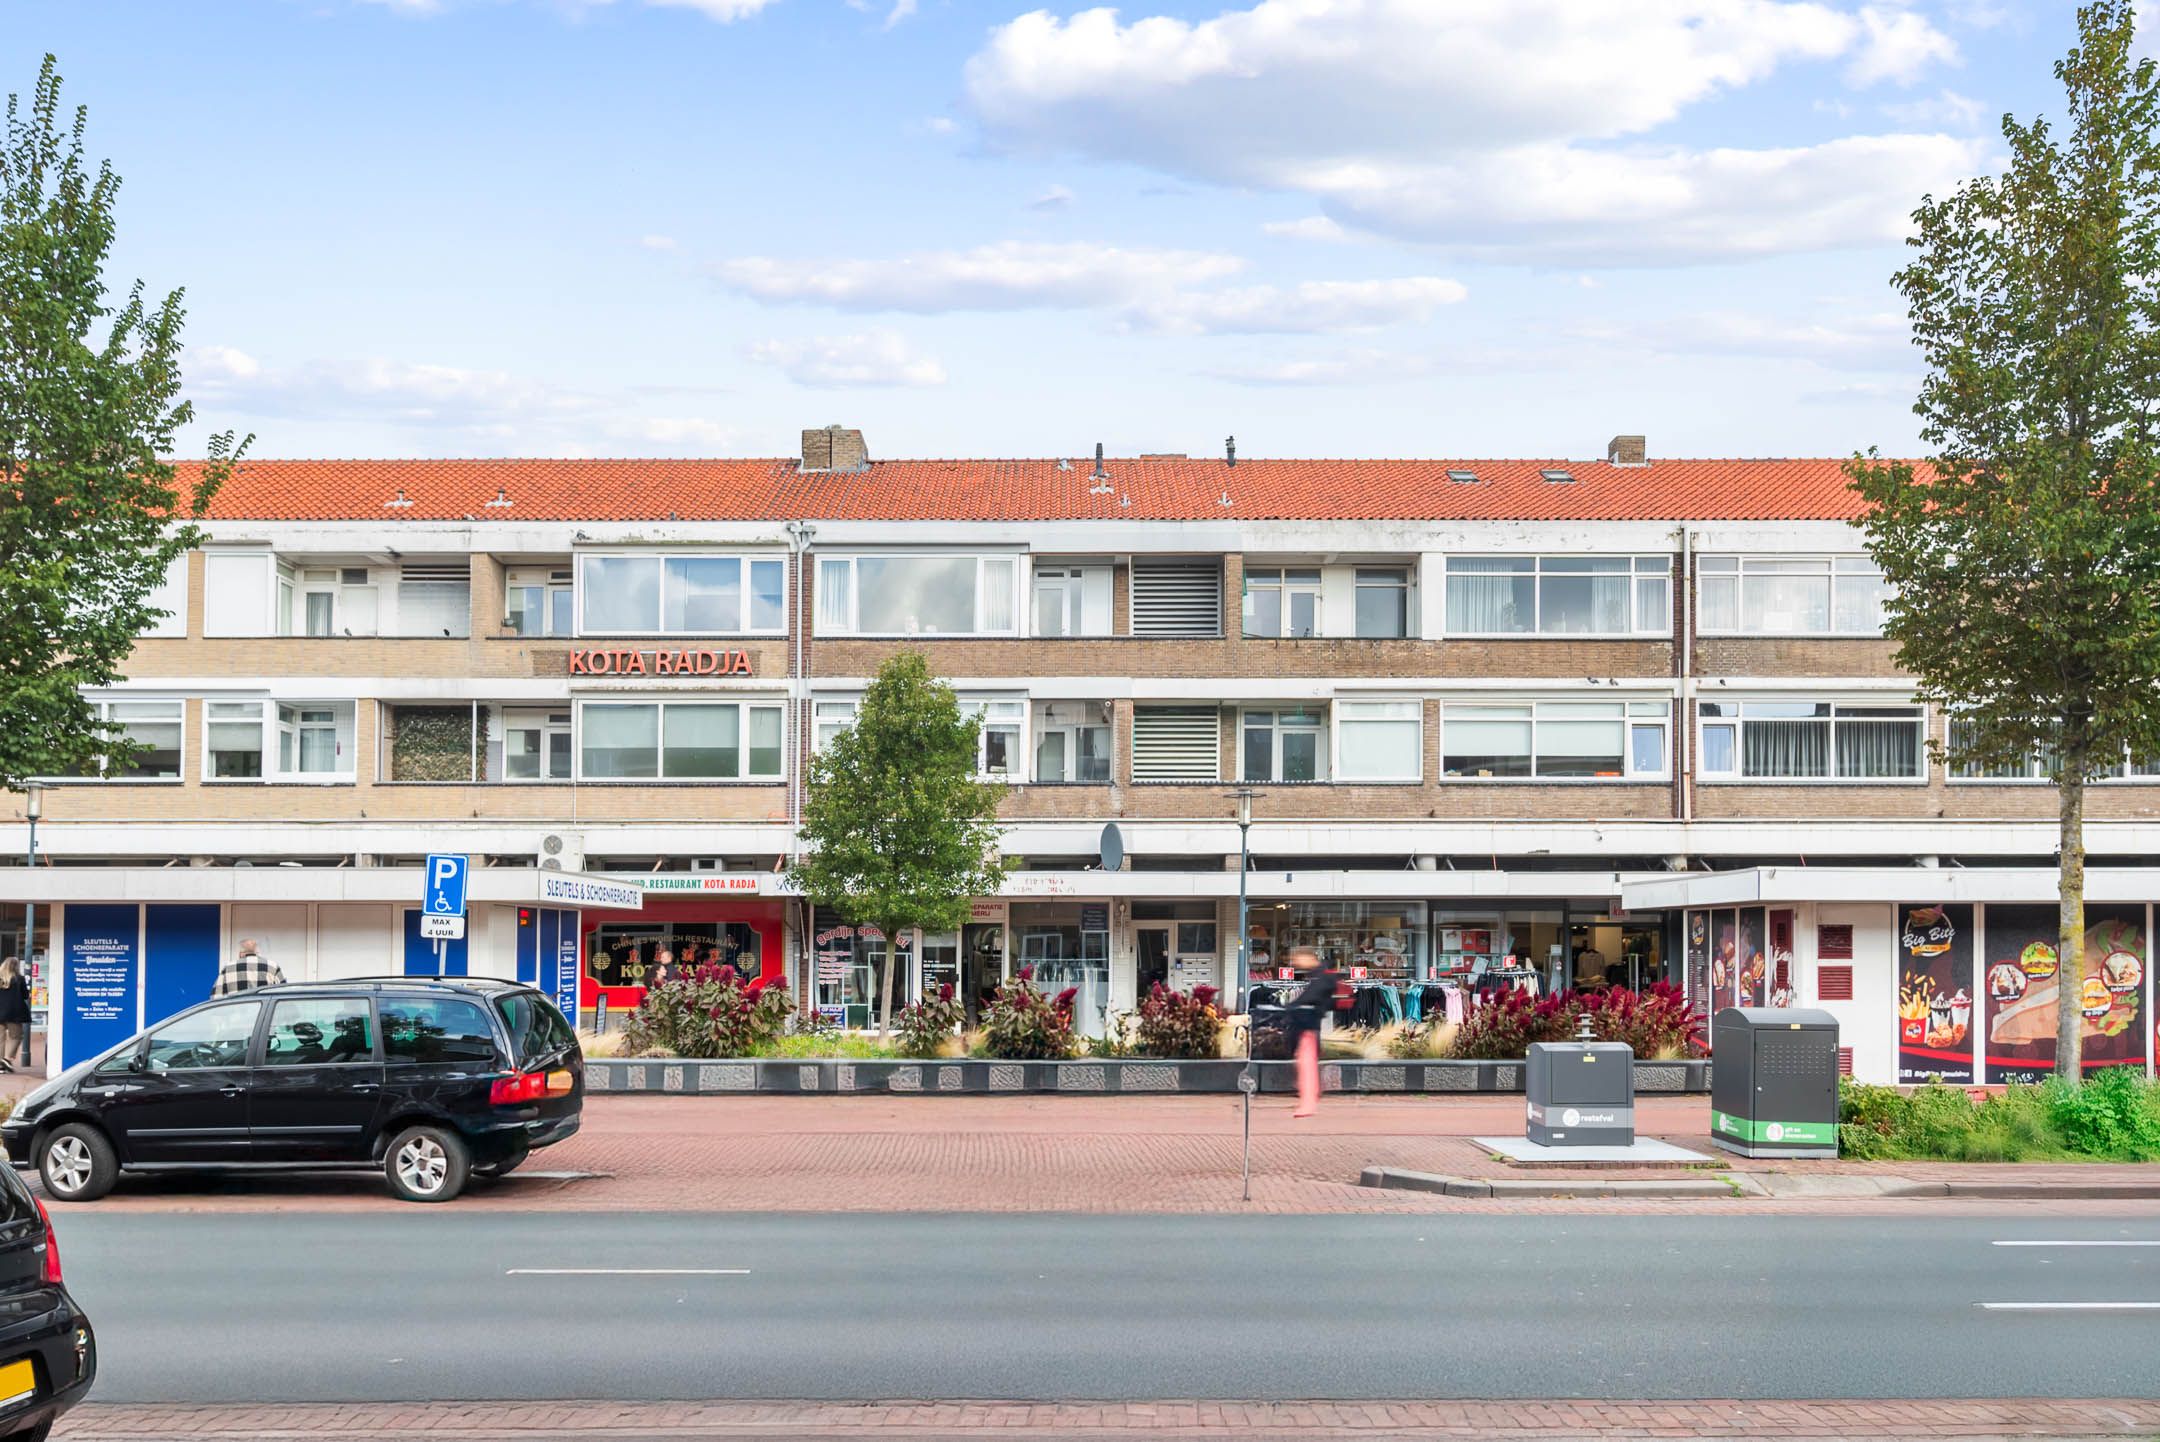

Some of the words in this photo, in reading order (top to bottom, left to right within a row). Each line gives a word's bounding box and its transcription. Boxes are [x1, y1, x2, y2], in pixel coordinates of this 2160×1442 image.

[569, 649, 646, 674] KOTA
[655, 649, 753, 674] RADJA
[434, 858, 457, 889] P
[649, 879, 701, 889] RESTAURANT
[704, 879, 725, 889] KOTA
[729, 879, 756, 889] RADJA
[547, 879, 579, 899] SLEUTELS
[581, 883, 585, 900] &
[586, 884, 638, 905] SCHOENREPARATIE
[612, 936, 648, 950] CHINEES
[650, 935, 684, 943] INDISCH
[686, 935, 740, 950] RESTAURANT
[817, 926, 853, 946] gordijn
[1902, 933, 1925, 947] Big
[1928, 926, 1956, 941] Bite
